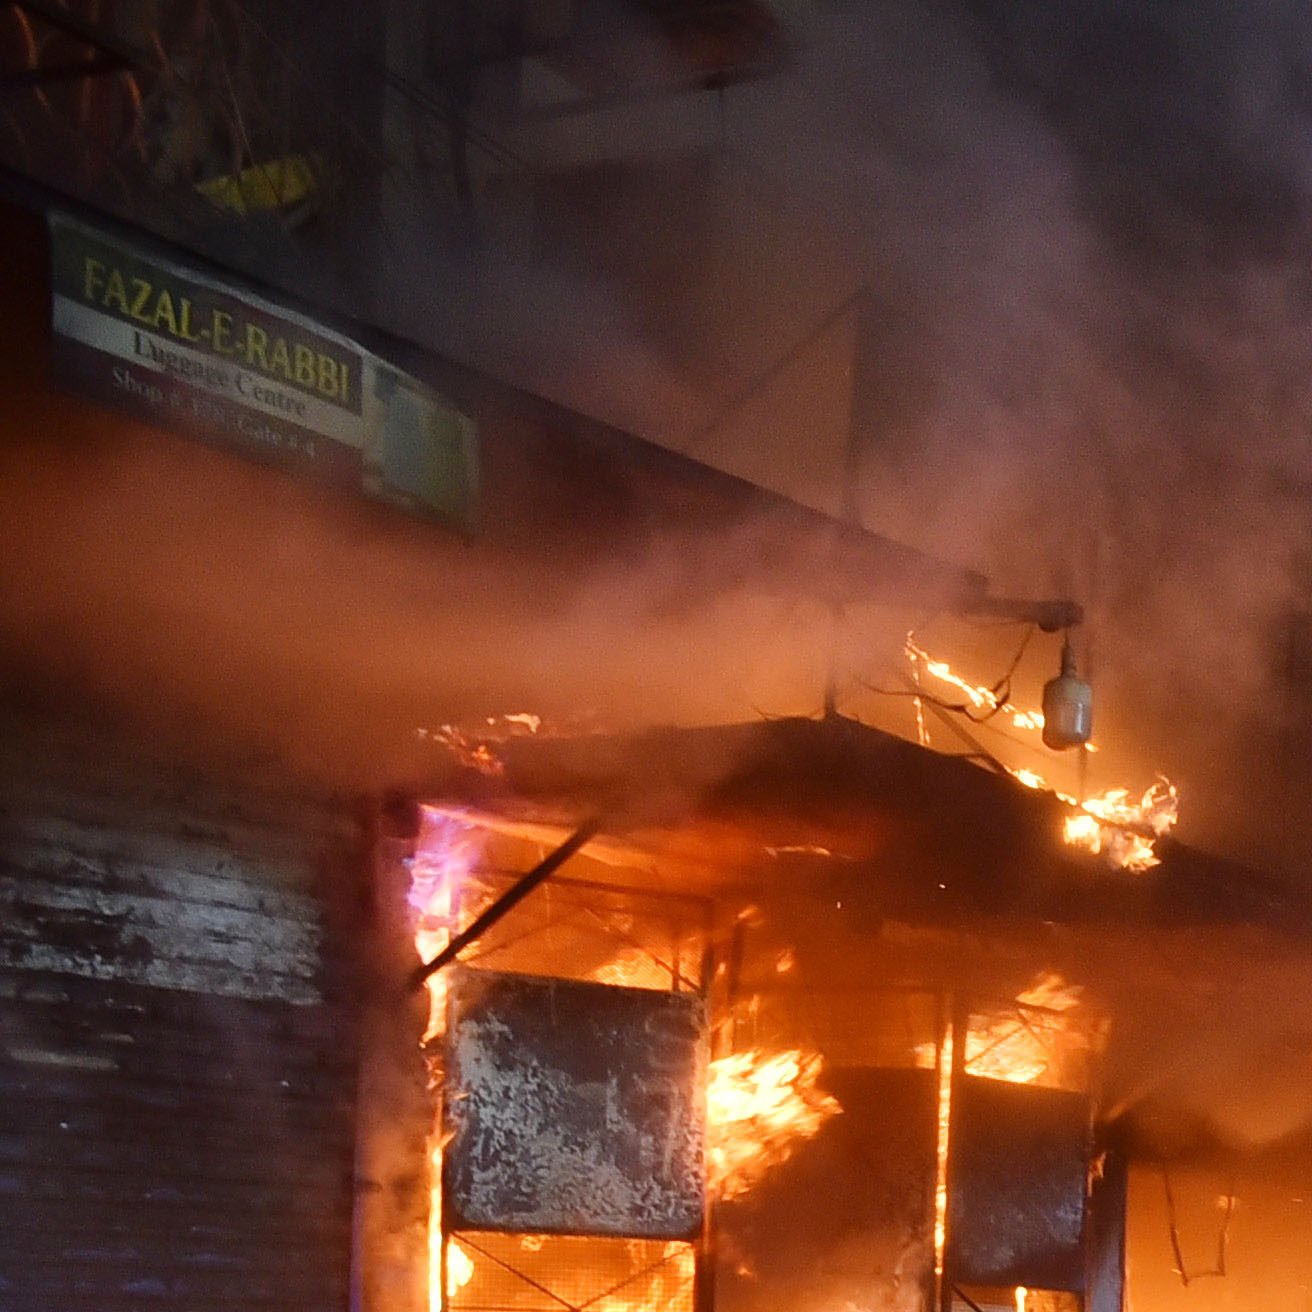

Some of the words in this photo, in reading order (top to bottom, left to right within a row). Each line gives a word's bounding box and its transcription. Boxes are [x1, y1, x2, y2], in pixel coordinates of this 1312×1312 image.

[111, 365, 163, 403] Shop
[132, 330, 231, 391] Luggage
[235, 369, 307, 417] Centre
